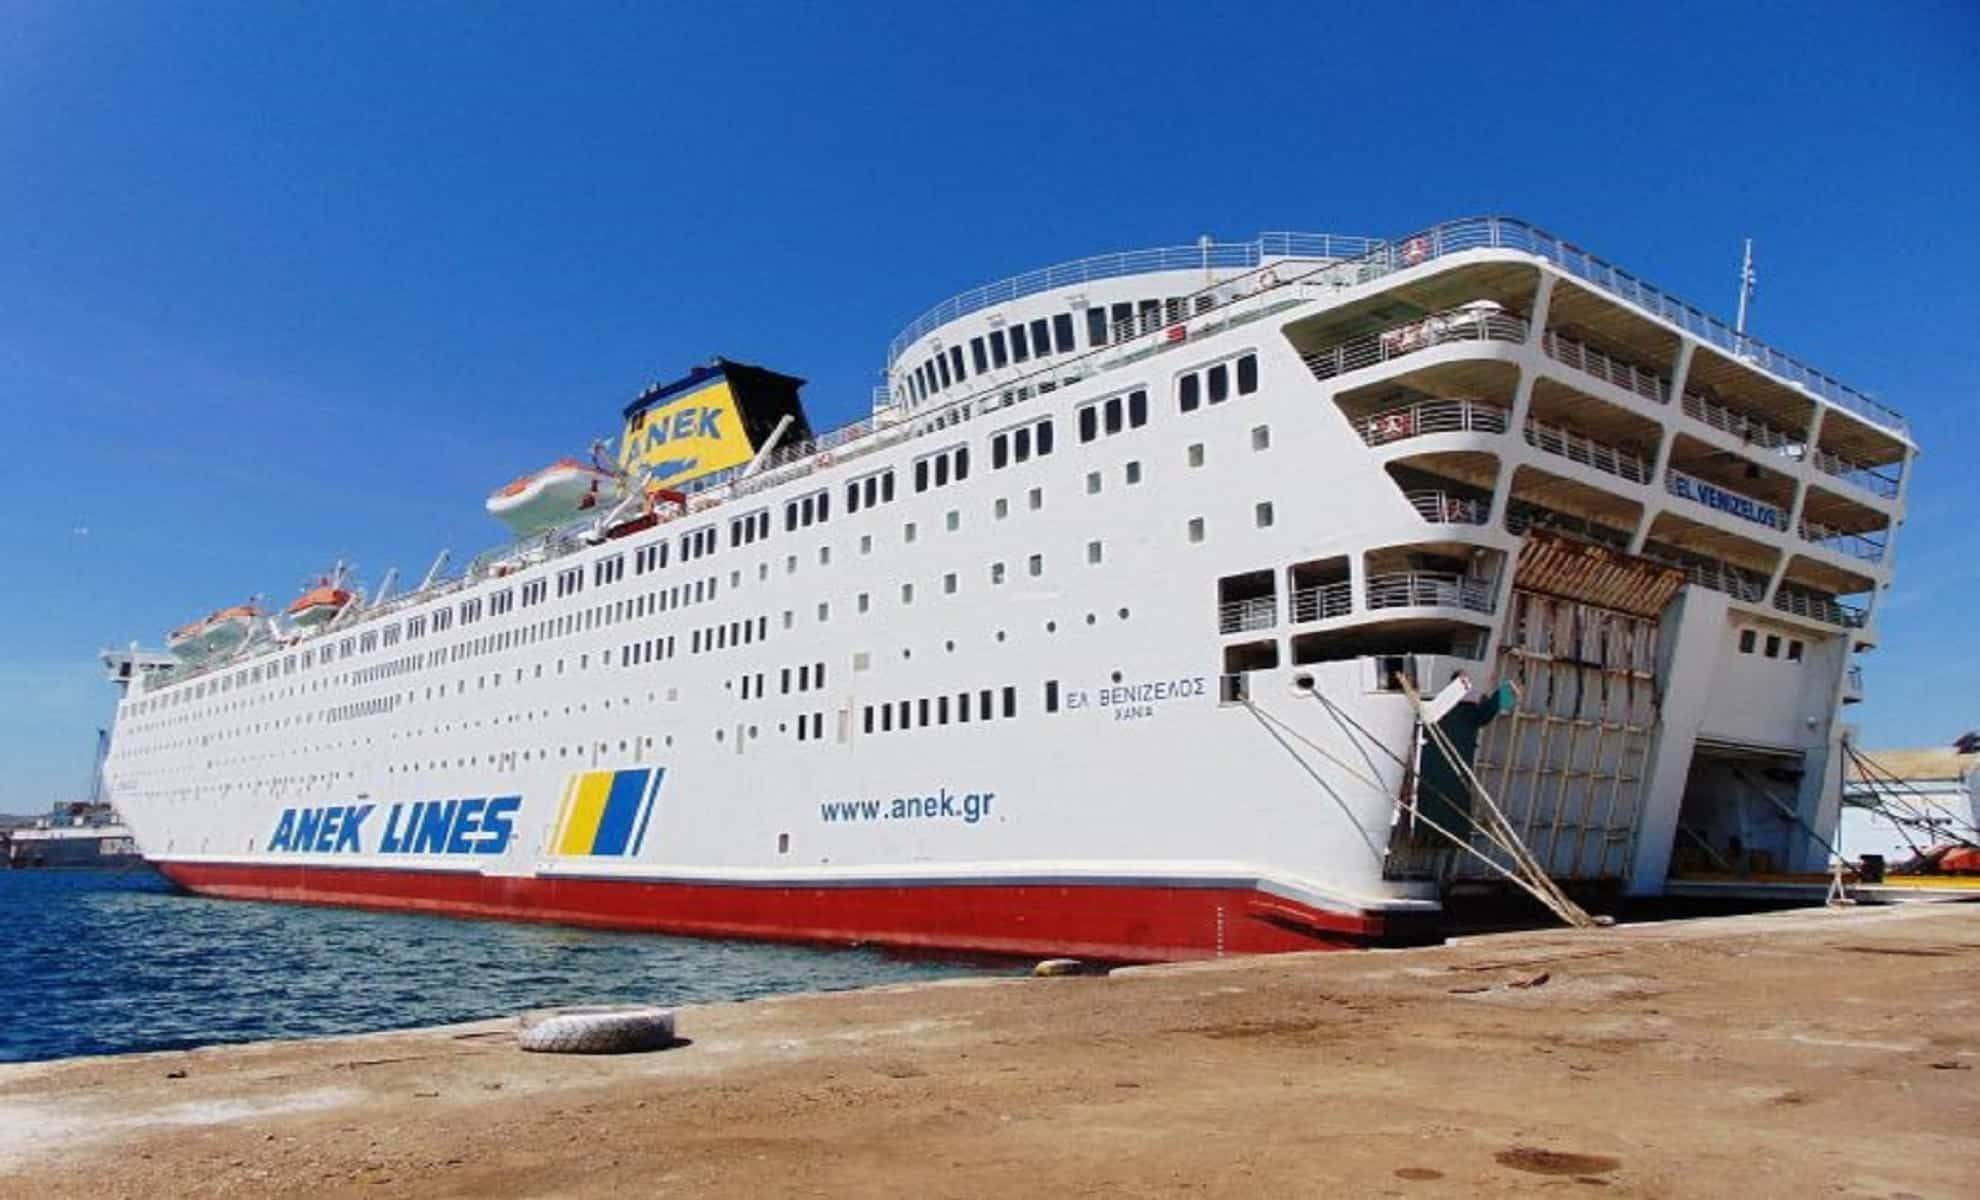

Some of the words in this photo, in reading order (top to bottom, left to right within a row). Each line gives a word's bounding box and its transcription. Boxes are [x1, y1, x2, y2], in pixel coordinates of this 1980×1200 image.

[628, 406, 722, 461] ANEK
[1676, 477, 1698, 501] EL
[1698, 483, 1777, 528] VENIZELOS
[1100, 677, 1206, 707] ΒΕΝΙΖΕΛΟΣ
[267, 804, 376, 852] ANEK
[378, 795, 523, 854] LINES
[821, 788, 995, 823] www.anek.gr
